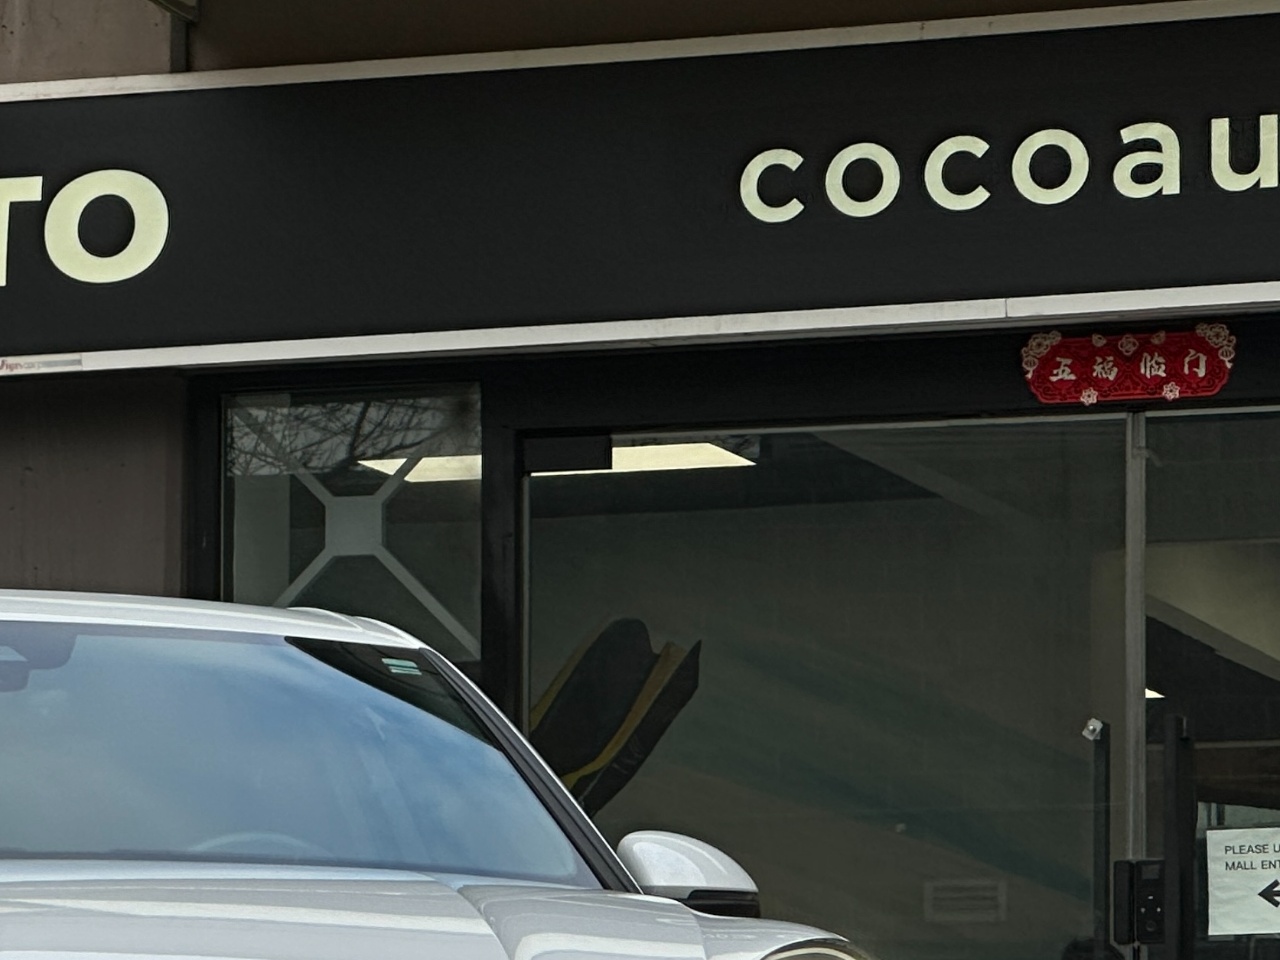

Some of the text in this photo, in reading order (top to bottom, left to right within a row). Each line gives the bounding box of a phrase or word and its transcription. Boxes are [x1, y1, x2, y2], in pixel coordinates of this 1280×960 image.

[739, 112, 1280, 223] cocoau
[1049, 349, 1207, 382] 五福临门
[1224, 844, 1269, 855] PLEASE
[1225, 861, 1257, 871] MALL
